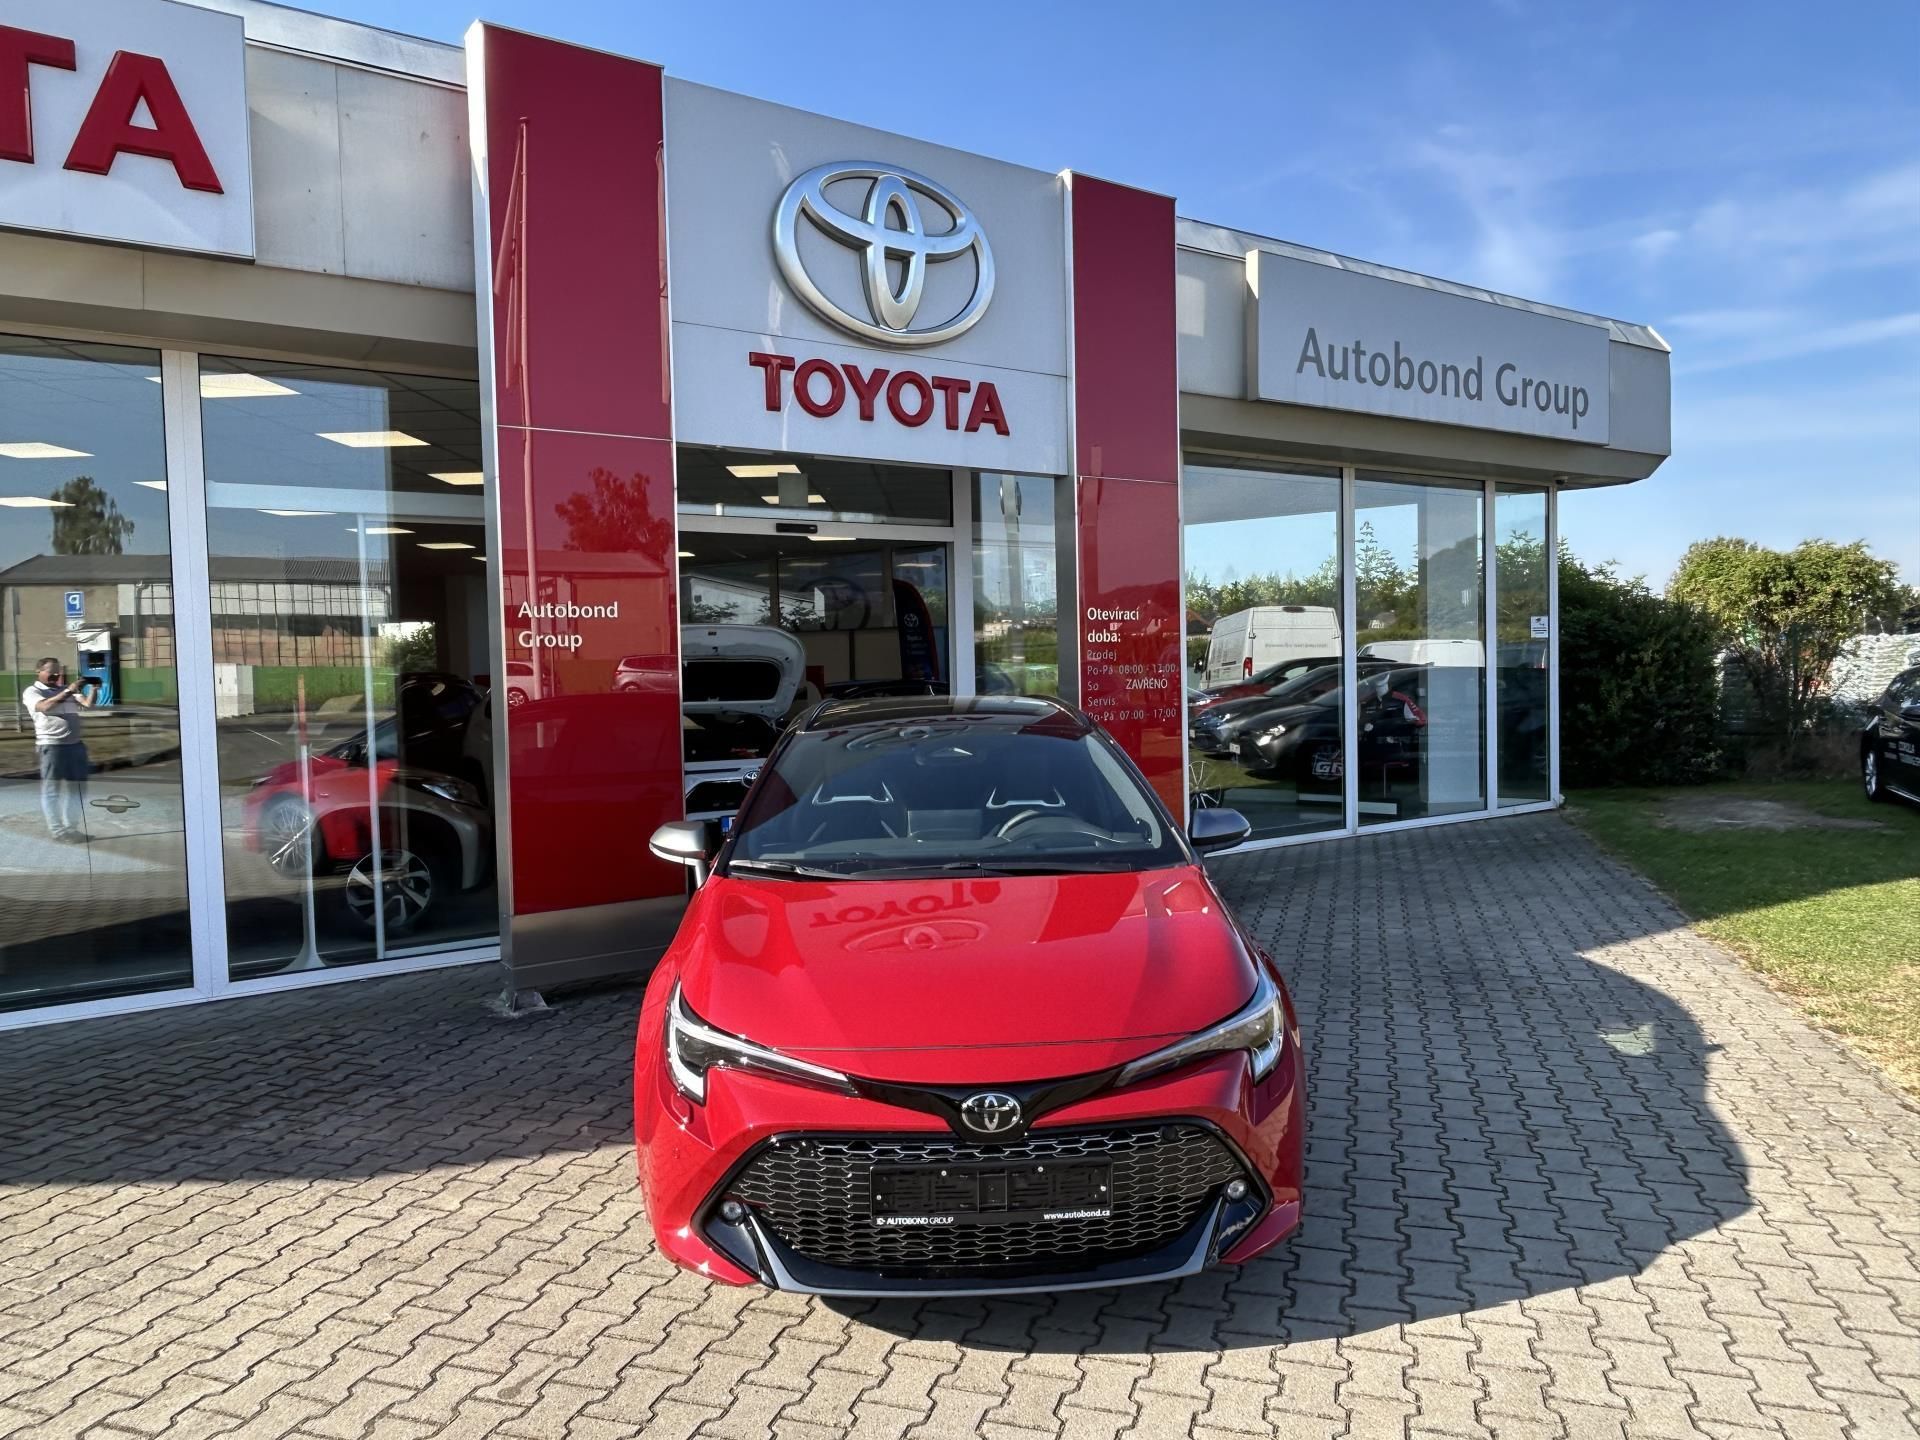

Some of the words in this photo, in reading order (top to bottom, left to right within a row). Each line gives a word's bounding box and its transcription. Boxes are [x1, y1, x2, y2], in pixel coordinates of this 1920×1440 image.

[1296, 326, 1483, 401] Autobond
[1495, 362, 1590, 430] Group
[748, 351, 1010, 436] TOYOTA
[518, 601, 618, 619] Autobond
[1087, 606, 1140, 621] Otevírací
[518, 630, 583, 652] Group
[1087, 629, 1121, 643] doba:
[1087, 649, 1117, 661] Prodej
[1118, 663, 1143, 674] 08:00
[1087, 680, 1099, 691] So
[1125, 676, 1168, 690] ZAVŘENO
[1087, 696, 1116, 707] Servis
[1119, 709, 1144, 720] 07:00
[1153, 708, 1177, 718] 17:00
[886, 1217, 928, 1225] AUTOBOND
[929, 1216, 954, 1224] GROUP
[1043, 1208, 1111, 1220] www.autobond.cz
